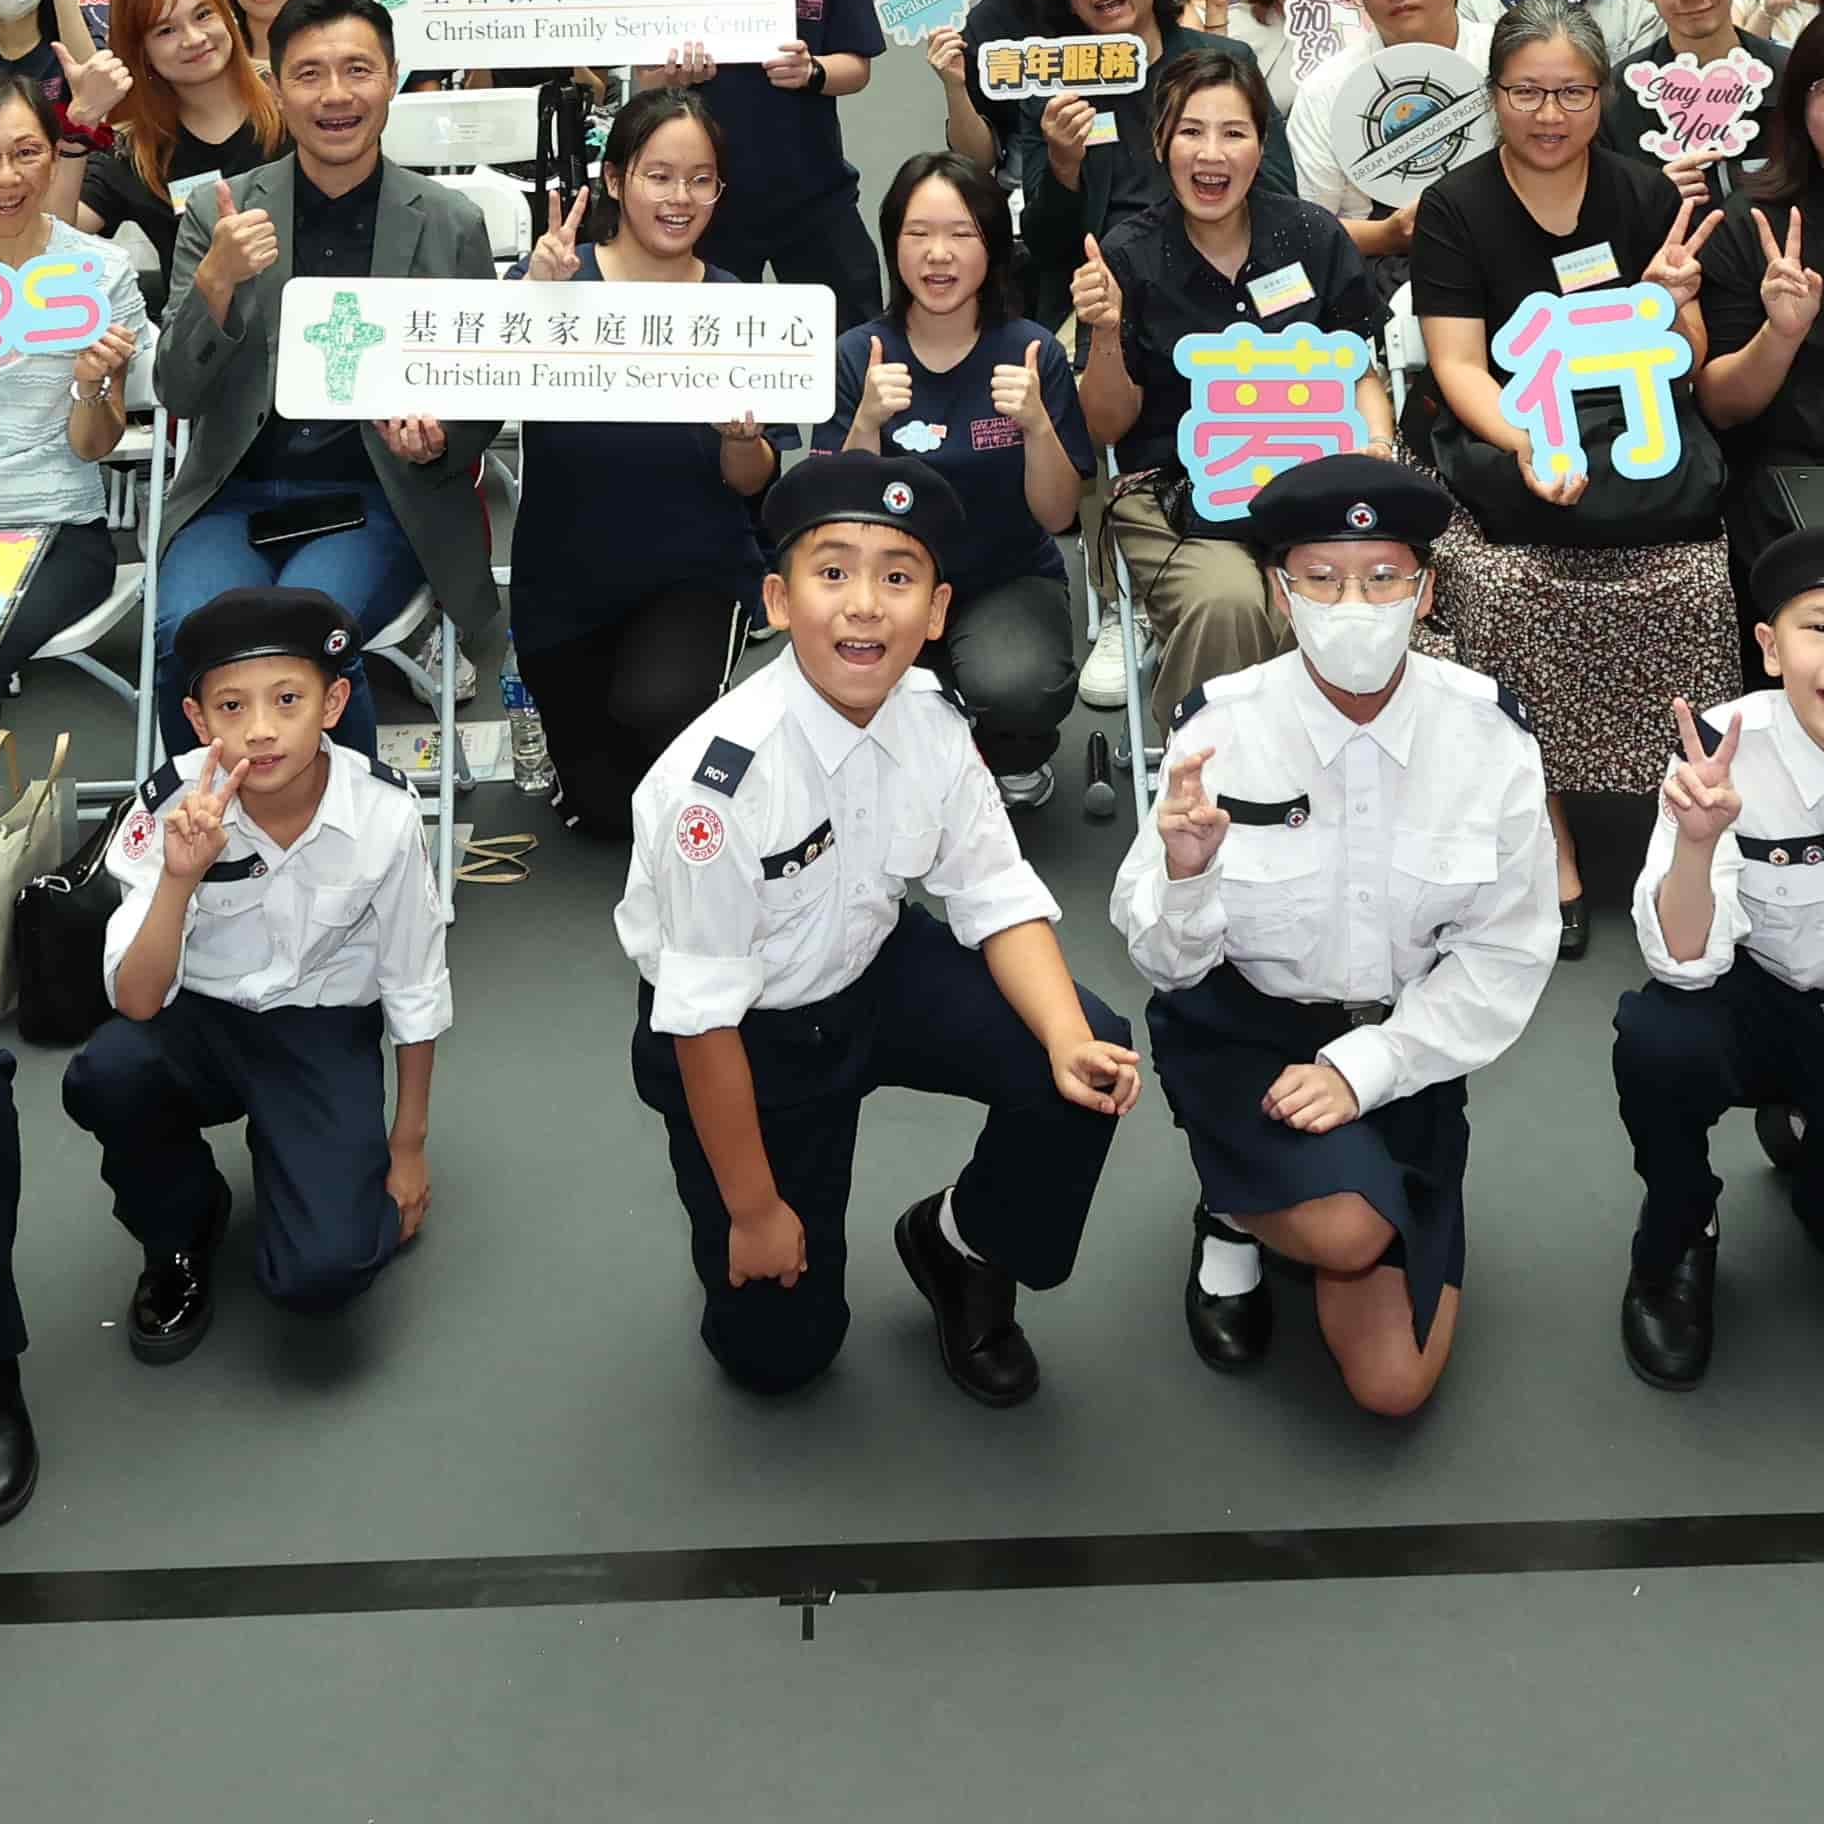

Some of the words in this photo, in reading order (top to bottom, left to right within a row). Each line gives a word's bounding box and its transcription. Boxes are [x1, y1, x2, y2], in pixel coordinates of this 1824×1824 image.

[425, 17, 527, 43] Christian
[533, 15, 608, 43] Family
[613, 15, 696, 38] Service
[701, 12, 778, 34] Centre
[986, 42, 1139, 89] 青年服務
[1644, 74, 1702, 108] Stay
[1705, 82, 1755, 107] with
[1668, 110, 1730, 154] You
[404, 308, 816, 348] 基督教家庭服務中心
[404, 360, 524, 389] Christian
[530, 361, 617, 393] Family
[623, 362, 720, 390] Service
[727, 366, 815, 392] Centre
[1188, 339, 1358, 508] 夢
[1509, 297, 1677, 476] 行
[704, 765, 729, 784] RCY
